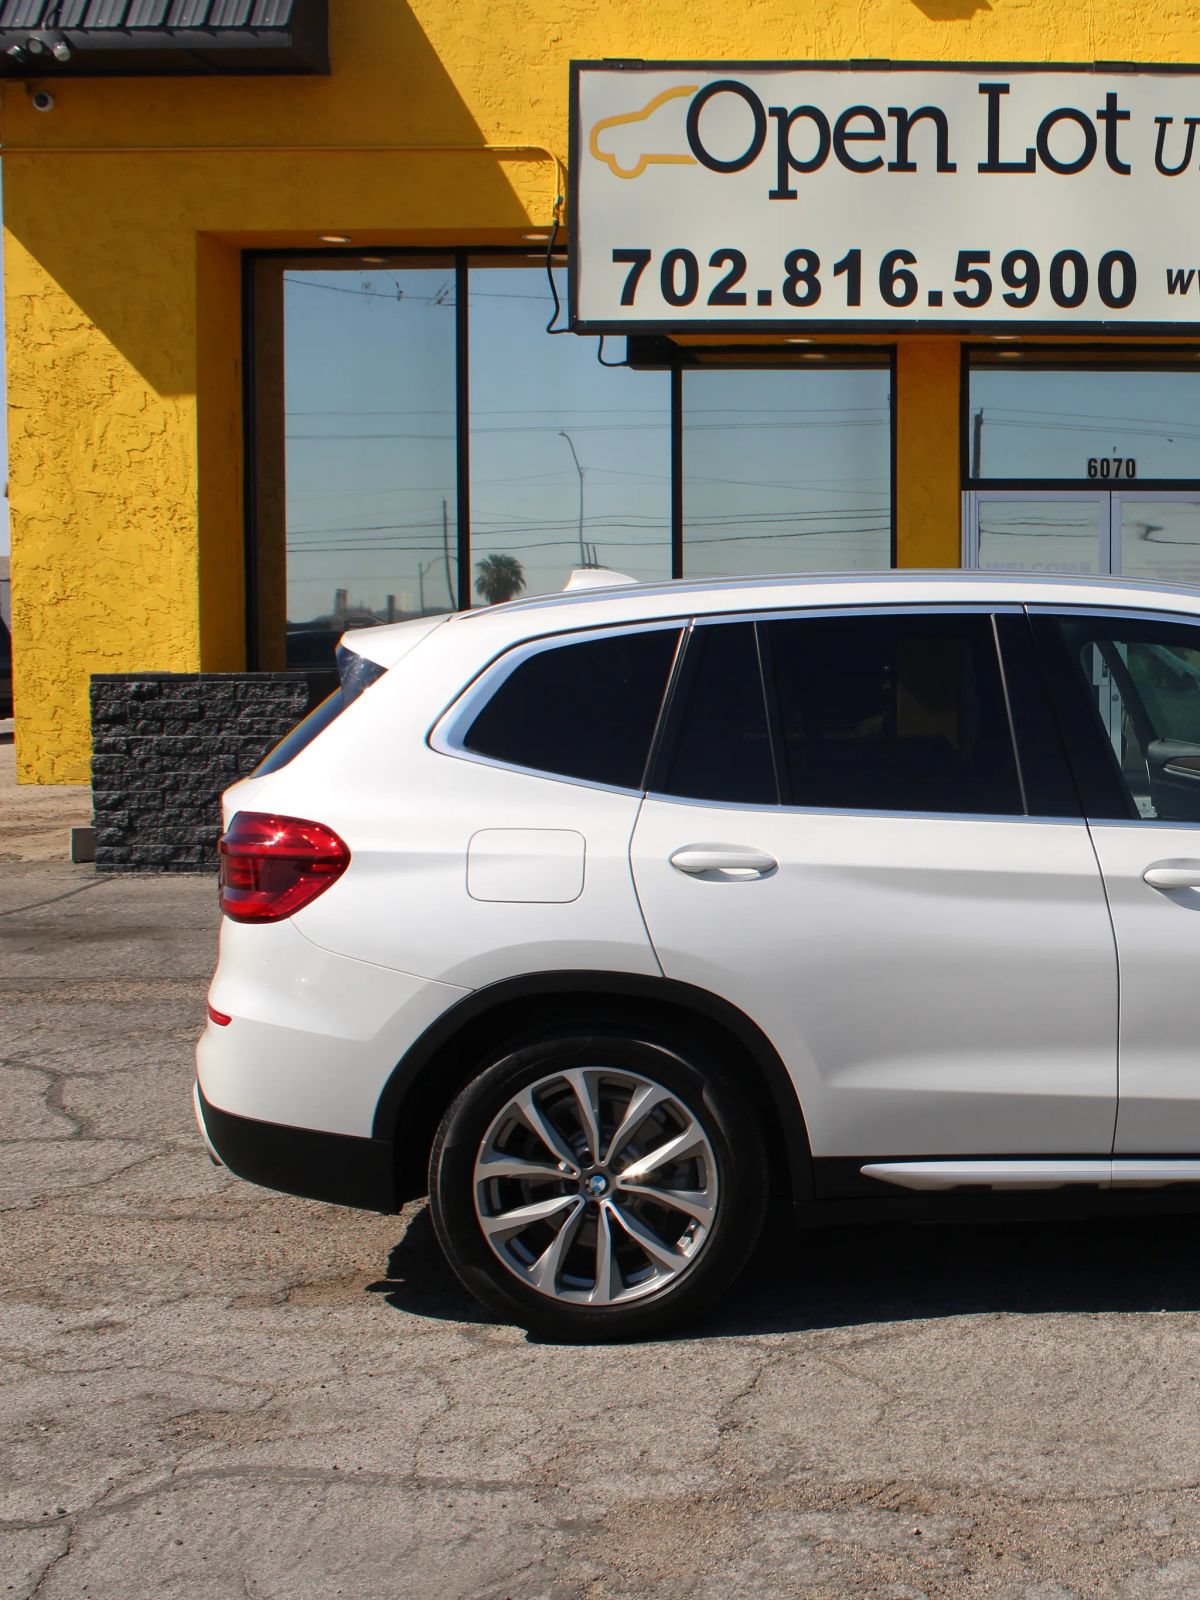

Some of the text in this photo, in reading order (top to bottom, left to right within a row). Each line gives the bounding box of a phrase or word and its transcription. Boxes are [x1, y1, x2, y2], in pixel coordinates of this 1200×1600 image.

[686, 79, 957, 200] Open
[977, 82, 1132, 176] Lot
[612, 247, 1138, 309] 702.816.5900
[1087, 457, 1136, 479] 6070
